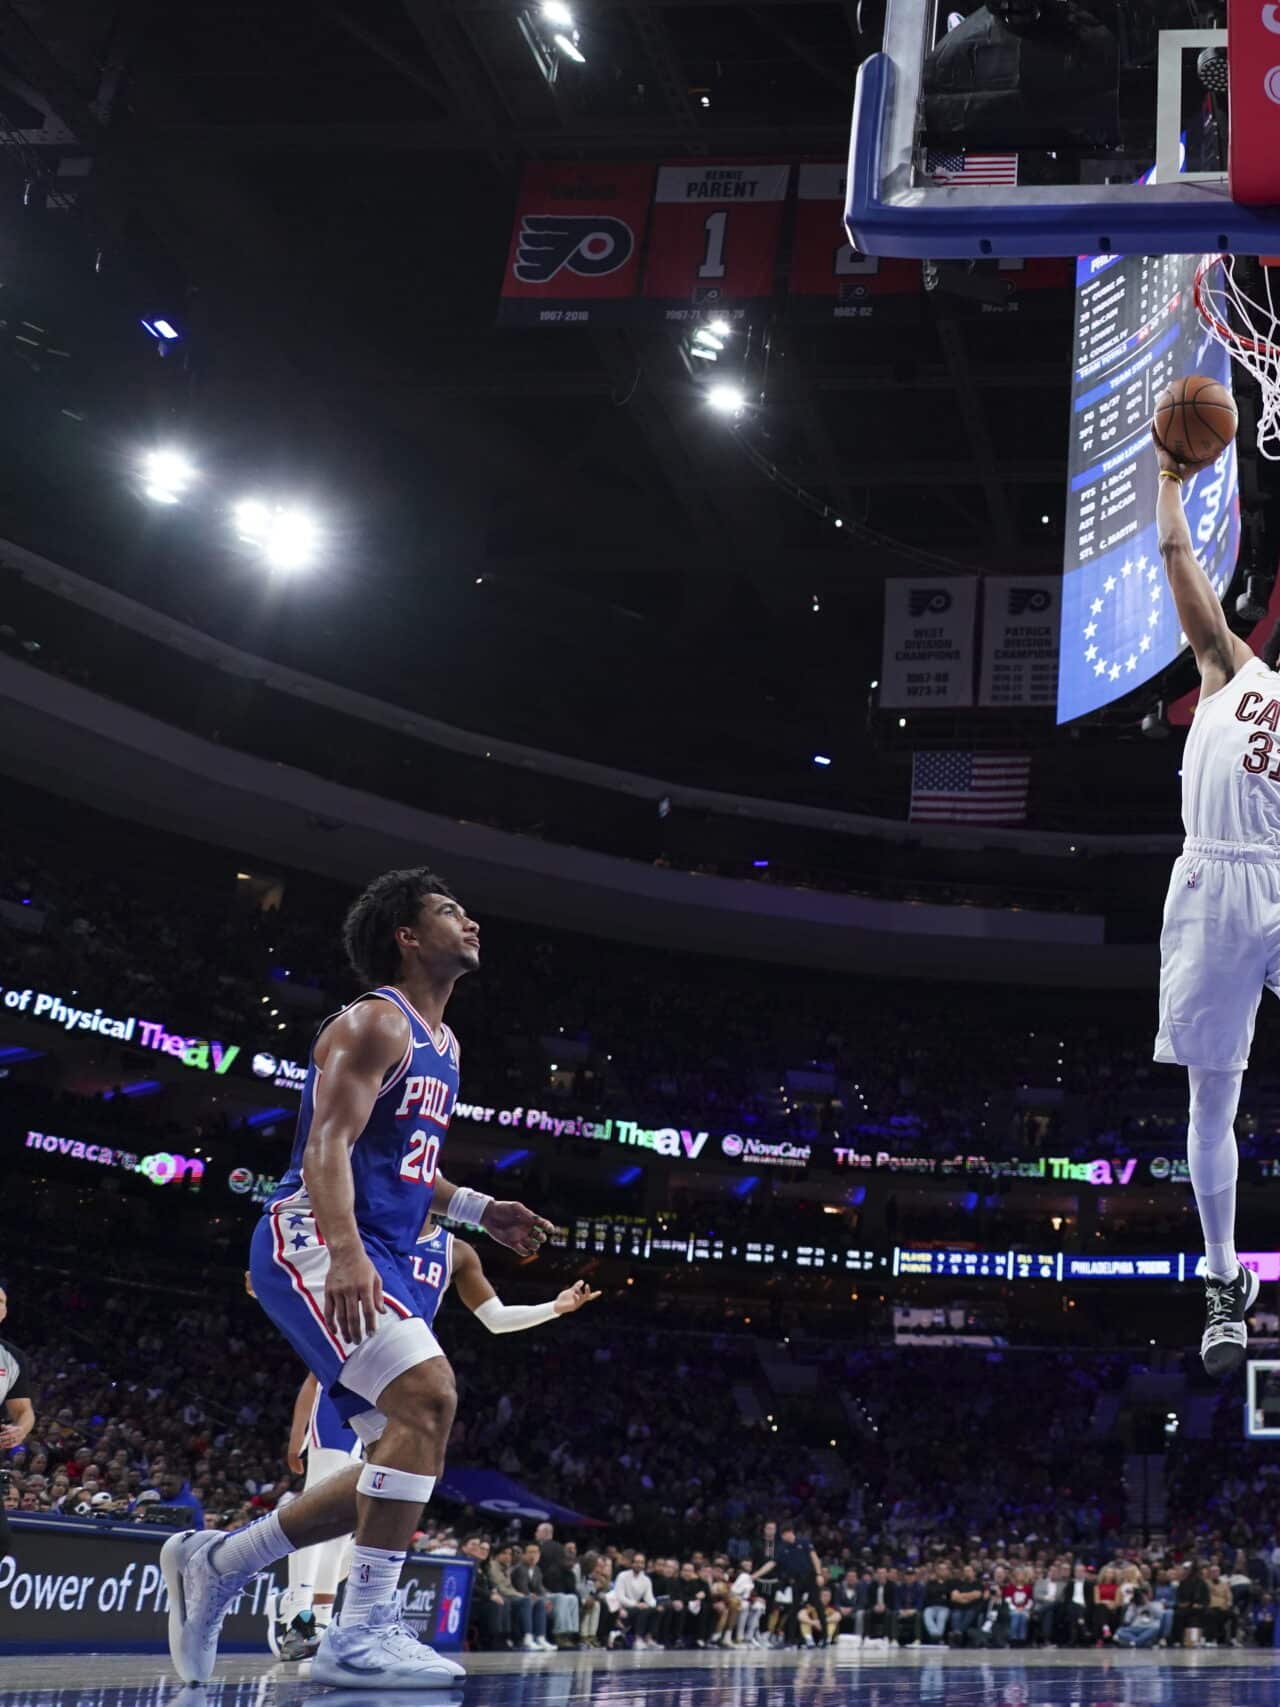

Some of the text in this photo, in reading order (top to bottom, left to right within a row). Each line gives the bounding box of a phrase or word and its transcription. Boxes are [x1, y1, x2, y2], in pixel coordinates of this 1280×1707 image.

[687, 181, 758, 198] PARENT
[699, 210, 729, 279] 1
[896, 650, 961, 661] CHAMPIONS
[904, 640, 953, 650] DIVISION
[4, 989, 33, 1011] of
[34, 993, 136, 1042] Physical
[395, 1076, 449, 1129] PHIL
[499, 1106, 523, 1126] of
[525, 1109, 612, 1141] Physical
[400, 1129, 440, 1188] 20
[743, 1139, 812, 1160] NovaCare
[834, 1147, 872, 1168] The
[876, 1151, 936, 1173] Power
[939, 1155, 963, 1173] of
[965, 1156, 1046, 1179] Physical
[1019, 1264, 1051, 1278] 2 6
[1071, 1261, 1134, 1274] PHILADELPHIA
[98, 1562, 136, 1613] of
[438, 1595, 462, 1635] 76
